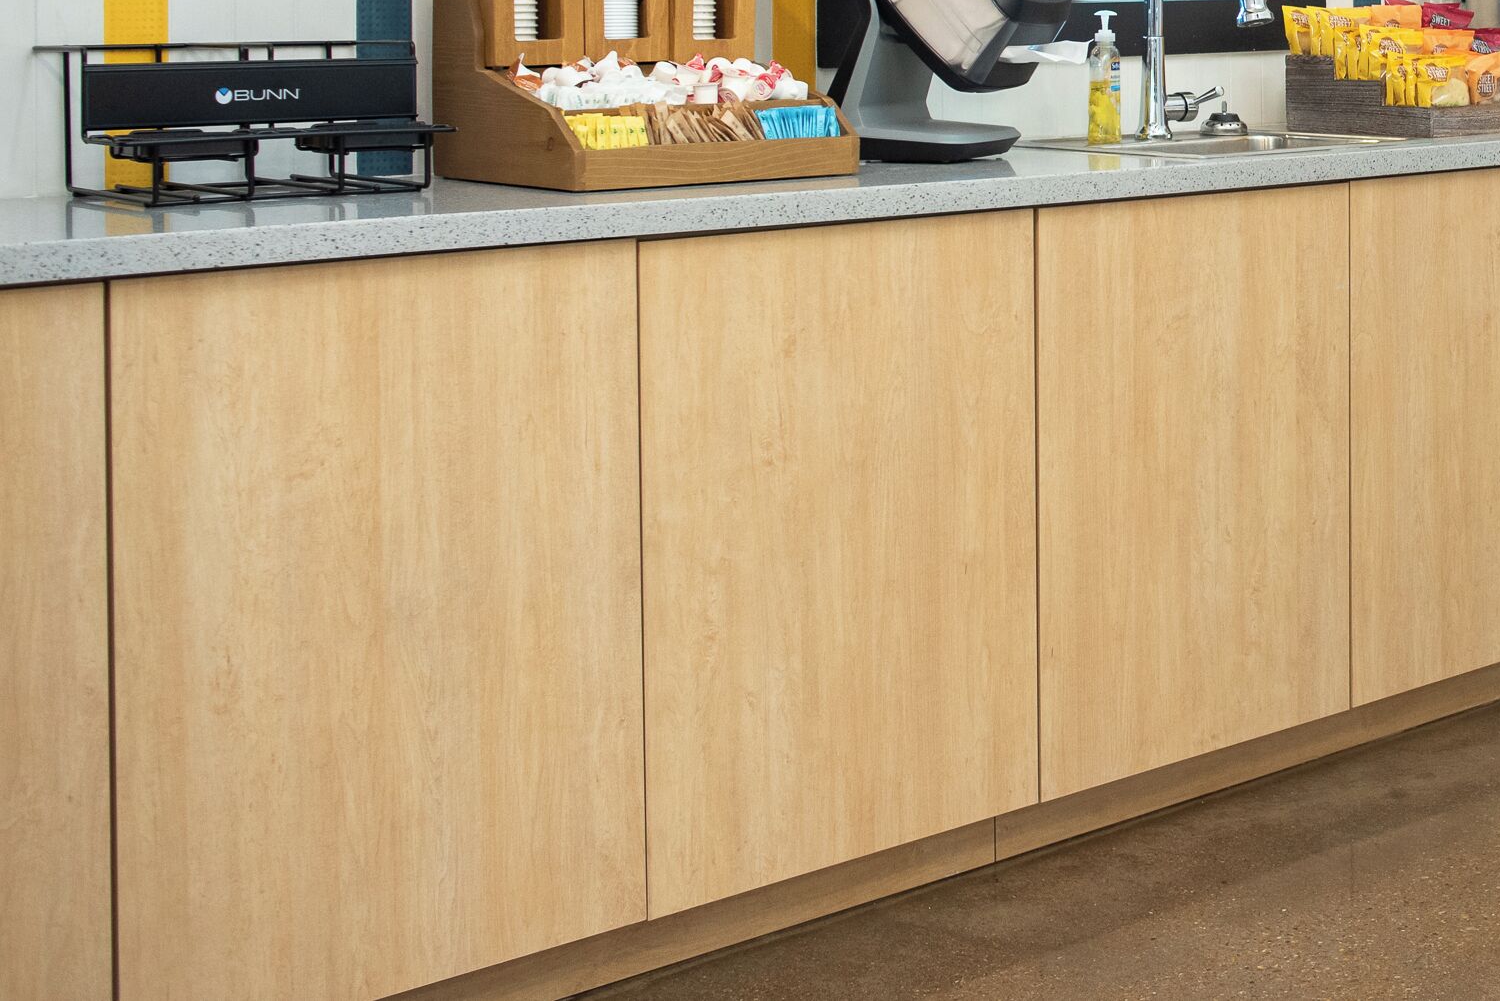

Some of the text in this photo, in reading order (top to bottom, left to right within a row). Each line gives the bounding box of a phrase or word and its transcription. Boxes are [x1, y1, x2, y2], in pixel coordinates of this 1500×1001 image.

[1431, 14, 1451, 27] SWEET
[1479, 74, 1495, 84] SWEET
[234, 88, 300, 101] BUNN
[1477, 83, 1496, 94] STREET
